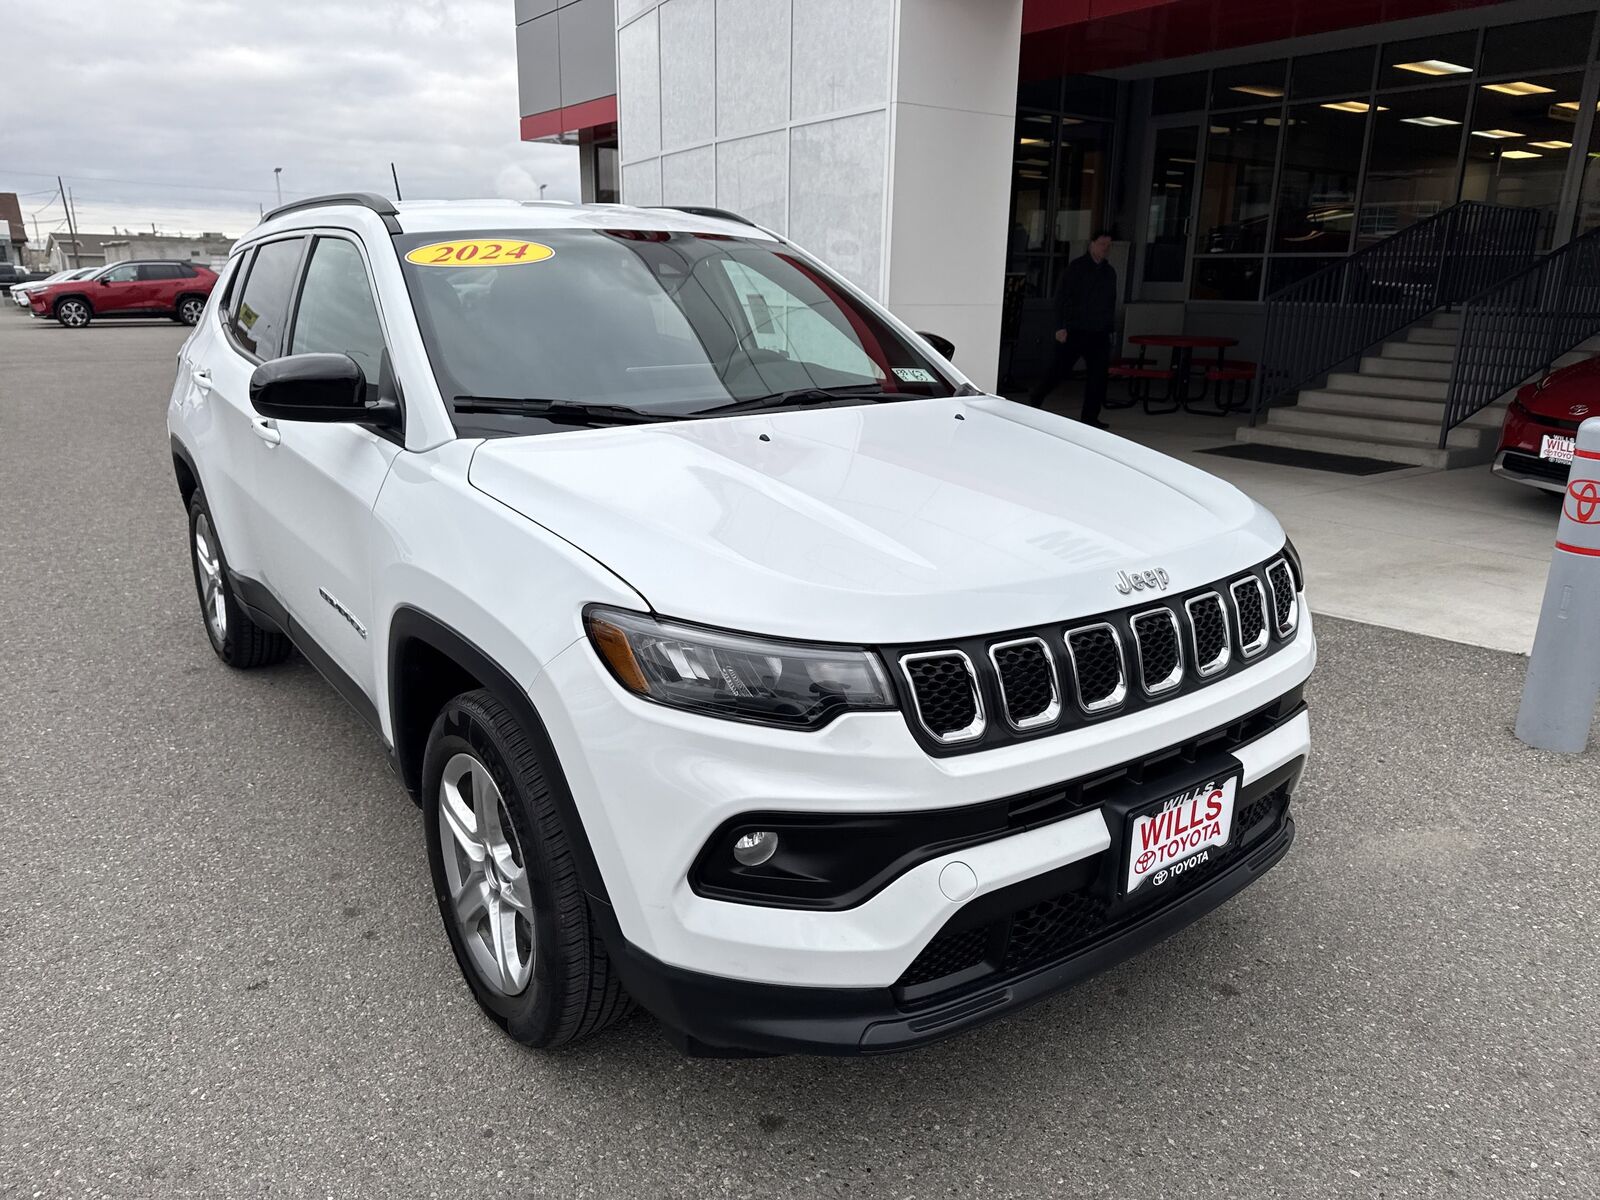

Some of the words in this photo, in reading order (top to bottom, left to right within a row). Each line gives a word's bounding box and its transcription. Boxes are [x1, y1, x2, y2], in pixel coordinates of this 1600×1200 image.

[430, 243, 529, 263] 2024
[1547, 439, 1573, 453] WILL
[1554, 450, 1572, 459] TOYO
[1115, 567, 1169, 595] Jeep
[1163, 781, 1215, 812] WILLS
[1141, 789, 1223, 851] WILLS
[1158, 821, 1221, 862] TOYOTA
[1170, 850, 1209, 877] TOYOTA
